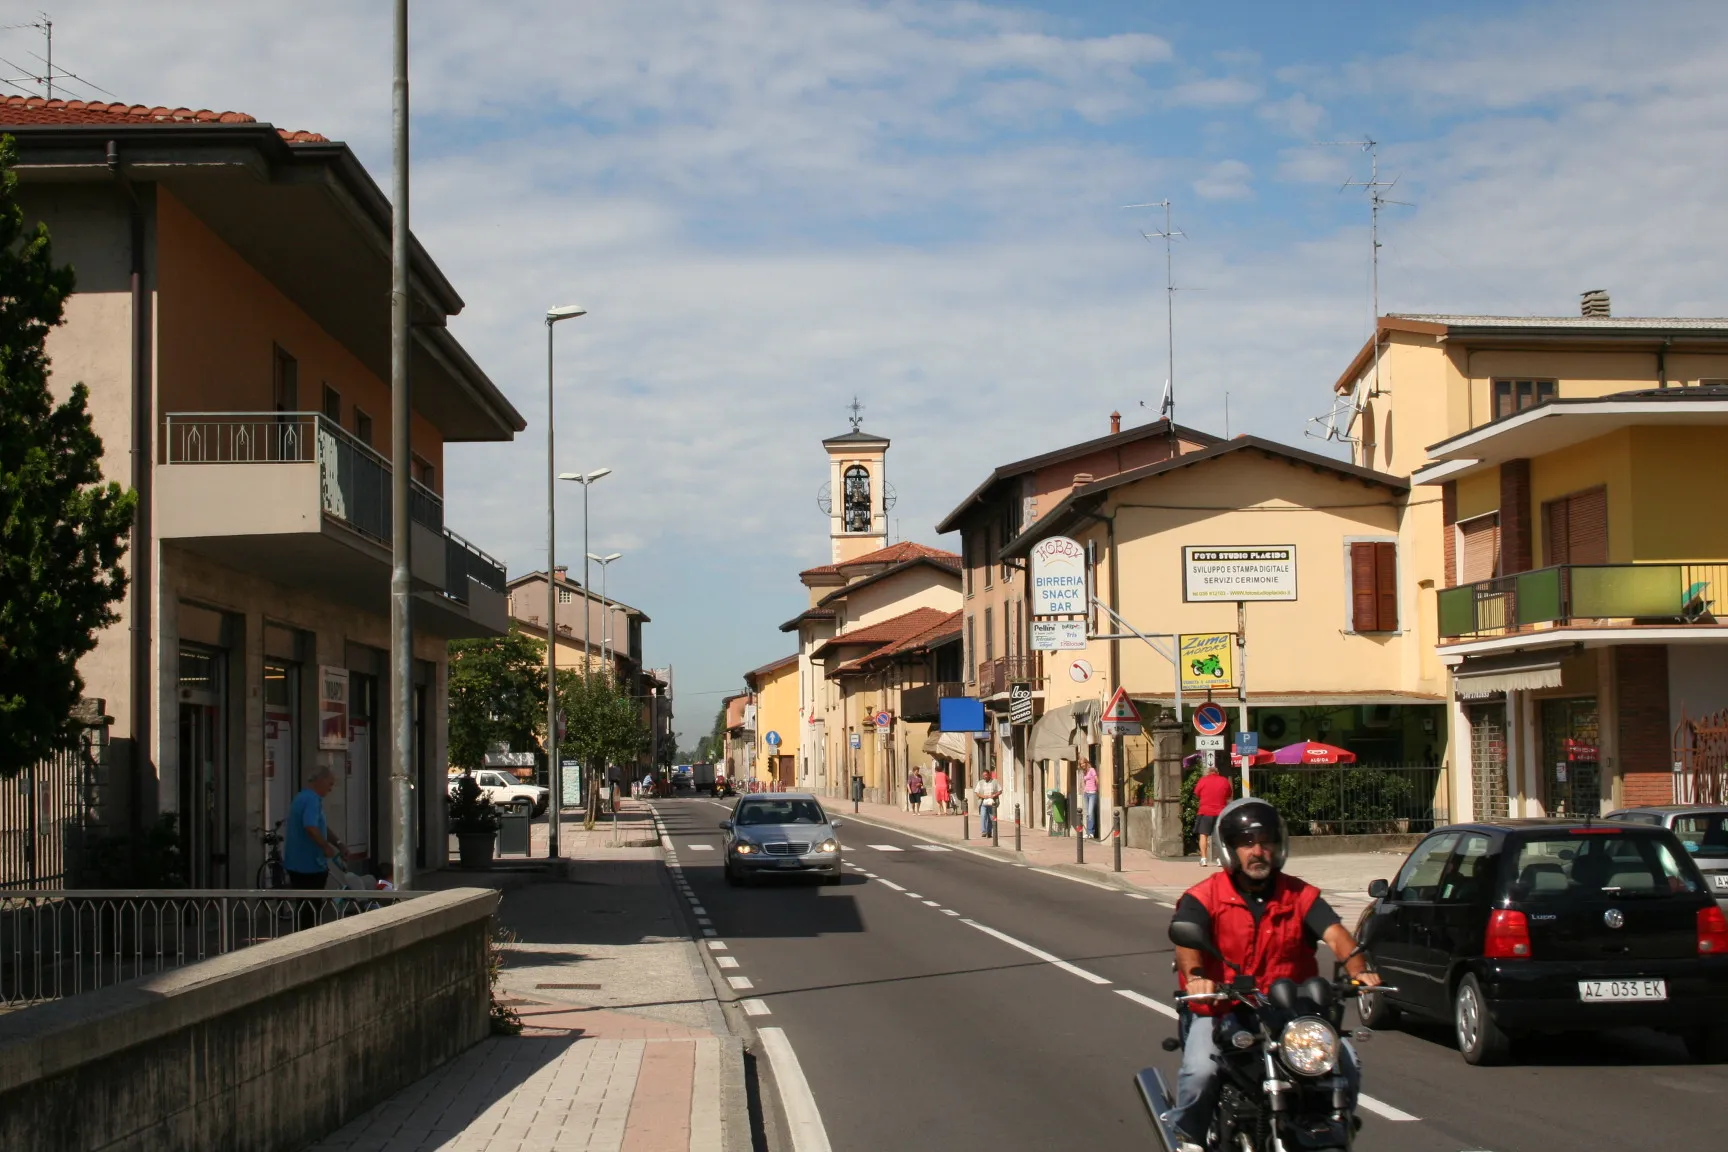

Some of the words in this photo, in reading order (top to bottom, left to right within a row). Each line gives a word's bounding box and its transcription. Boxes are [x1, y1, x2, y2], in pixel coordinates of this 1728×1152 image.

[1036, 540, 1082, 561] HOBBY
[1194, 552, 1217, 560] FOTO
[1218, 552, 1248, 560] STUDIO
[1232, 565, 1258, 573] STAMPA
[1259, 565, 1289, 573] DIGITALE
[1036, 576, 1083, 587] BIRRERIA
[1235, 576, 1279, 584] CERIMONIE
[1042, 589, 1079, 599] SNACK
[1050, 602, 1072, 612] BAR
[1034, 623, 1056, 631] Pellini
[1181, 635, 1228, 650] Zuma
[1183, 643, 1227, 656] MOTORS
[1011, 710, 1031, 720] UOMO
[1243, 734, 1251, 743] P
[1585, 982, 1603, 997] AZ
[1611, 982, 1638, 996] 033
[1644, 981, 1662, 996] EK
